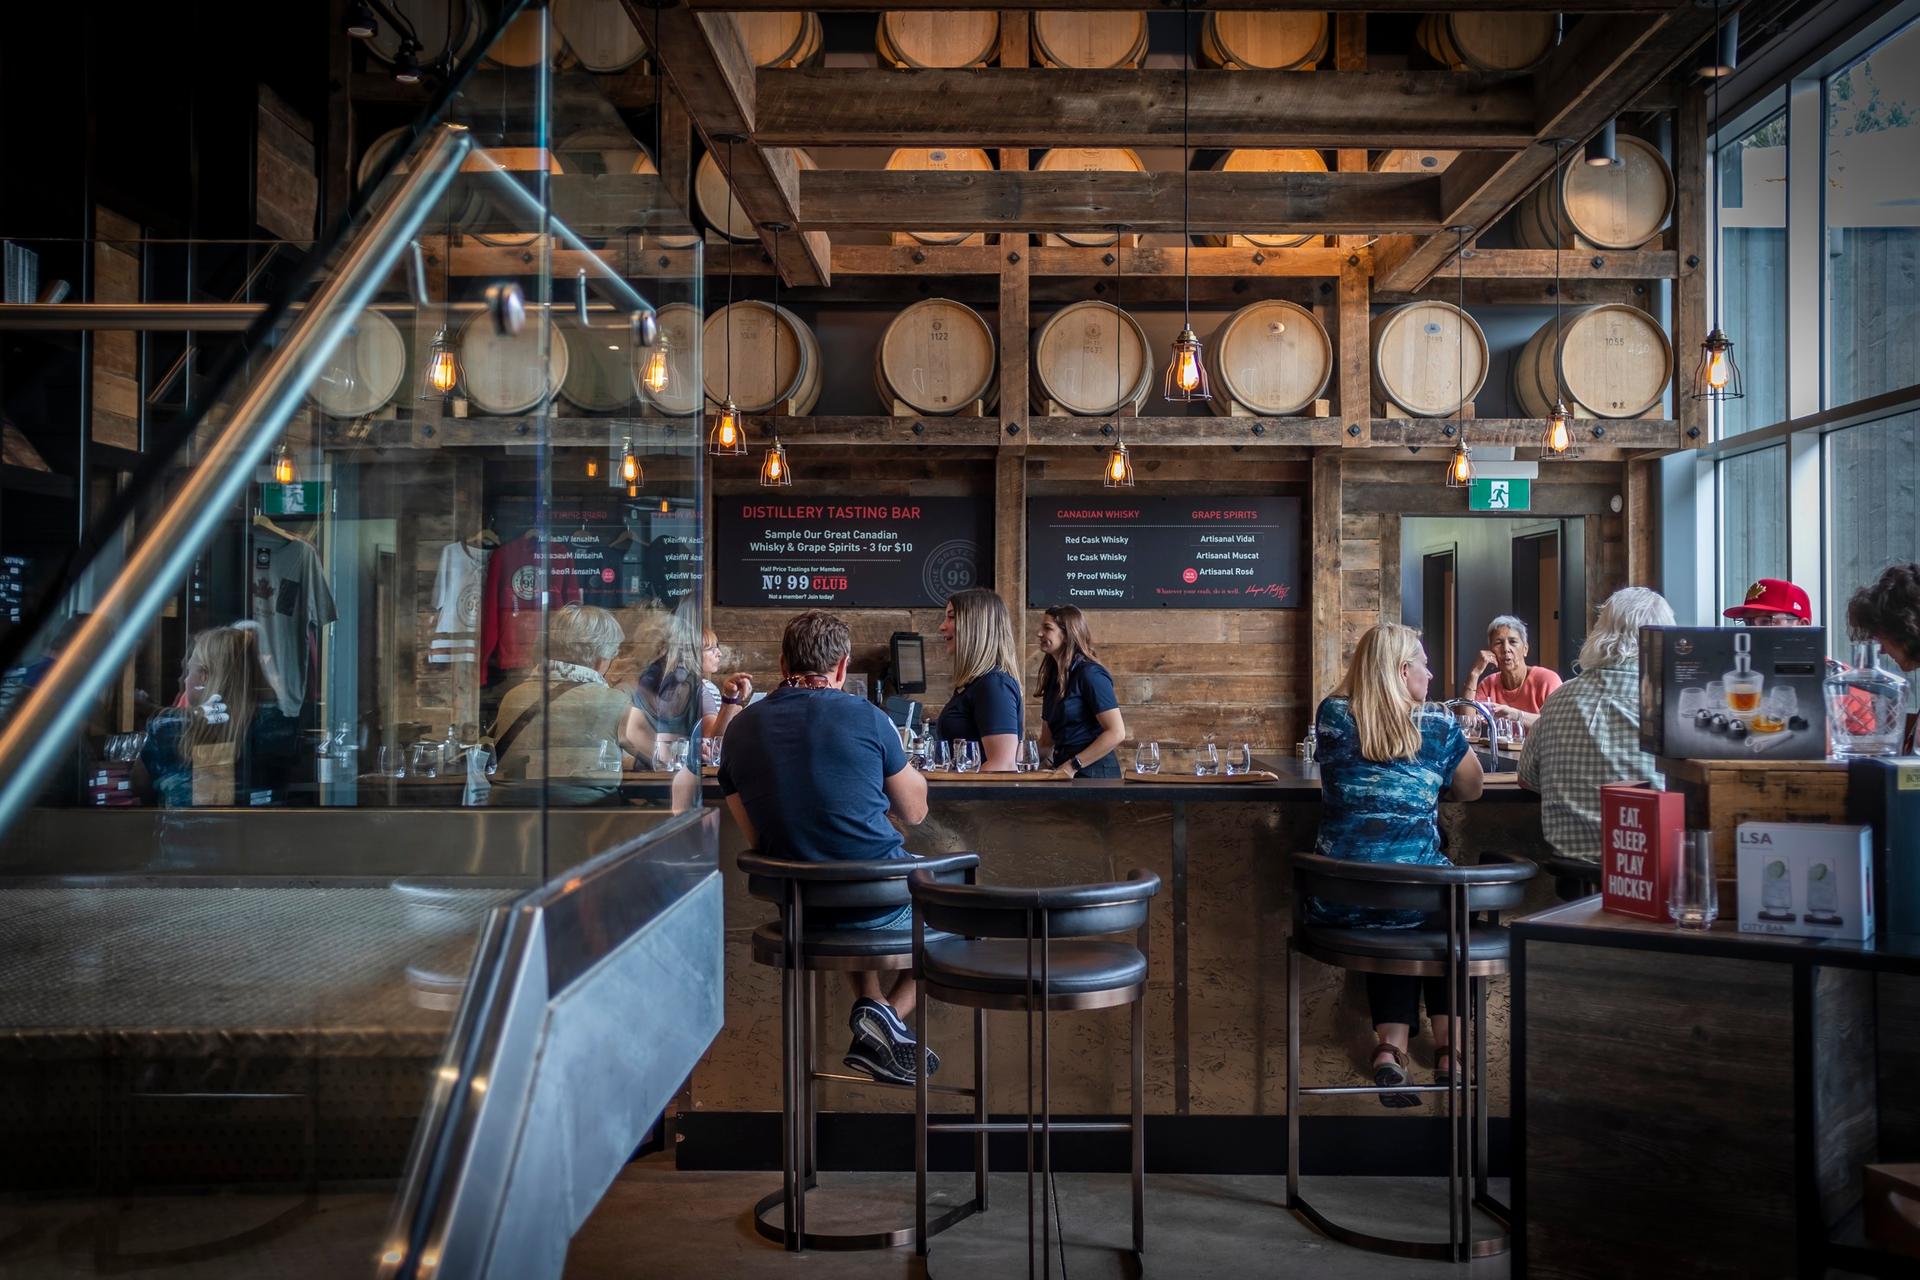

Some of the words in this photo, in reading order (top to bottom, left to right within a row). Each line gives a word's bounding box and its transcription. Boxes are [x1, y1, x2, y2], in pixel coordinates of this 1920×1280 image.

[743, 506, 823, 519] DISTILLERY
[827, 506, 888, 519] TASTING
[892, 506, 921, 519] BAR
[1057, 510, 1103, 518] CANADIAN
[1105, 510, 1140, 518] WHISKY
[1191, 511, 1221, 519] GRAPE
[1223, 511, 1258, 519] SPIRITS
[764, 530, 801, 541] Sample
[804, 530, 822, 539] Our
[824, 530, 851, 540] Great
[853, 530, 898, 540] Canadian
[1065, 536, 1080, 544] Red
[1081, 536, 1100, 544] Cask
[1101, 535, 1129, 545] Whisky
[1200, 535, 1235, 543] Artisanal
[1236, 535, 1255, 543] Vidal
[750, 542, 785, 553] Whisky
[787, 542, 795, 552] &
[797, 542, 826, 553] Grape
[828, 542, 860, 553] Spirits
[869, 542, 875, 552] 3
[877, 542, 892, 552] for
[894, 542, 913, 552] $10
[1067, 553, 1078, 561] Ice
[1080, 553, 1099, 561] Cask
[1099, 553, 1127, 563] Whisky
[1196, 552, 1231, 560] Artisanal
[1232, 552, 1259, 560] Muscat
[1066, 572, 1076, 580] 99
[1077, 572, 1098, 580] Proof
[1099, 572, 1127, 581] Whisky
[1199, 568, 1234, 576] Artisanal
[1235, 567, 1254, 576] Rosé
[787, 575, 810, 590] 99
[812, 578, 848, 590] CLUB
[947, 570, 970, 586] 99
[1070, 588, 1095, 596] Cream
[1096, 588, 1124, 597] Whisky
[1619, 806, 1643, 828] EAT.
[1612, 829, 1648, 853] SLEEP.
[1740, 832, 1773, 845] LSA
[1616, 852, 1644, 876] PLAY
[1608, 874, 1653, 901] HOCKEY
